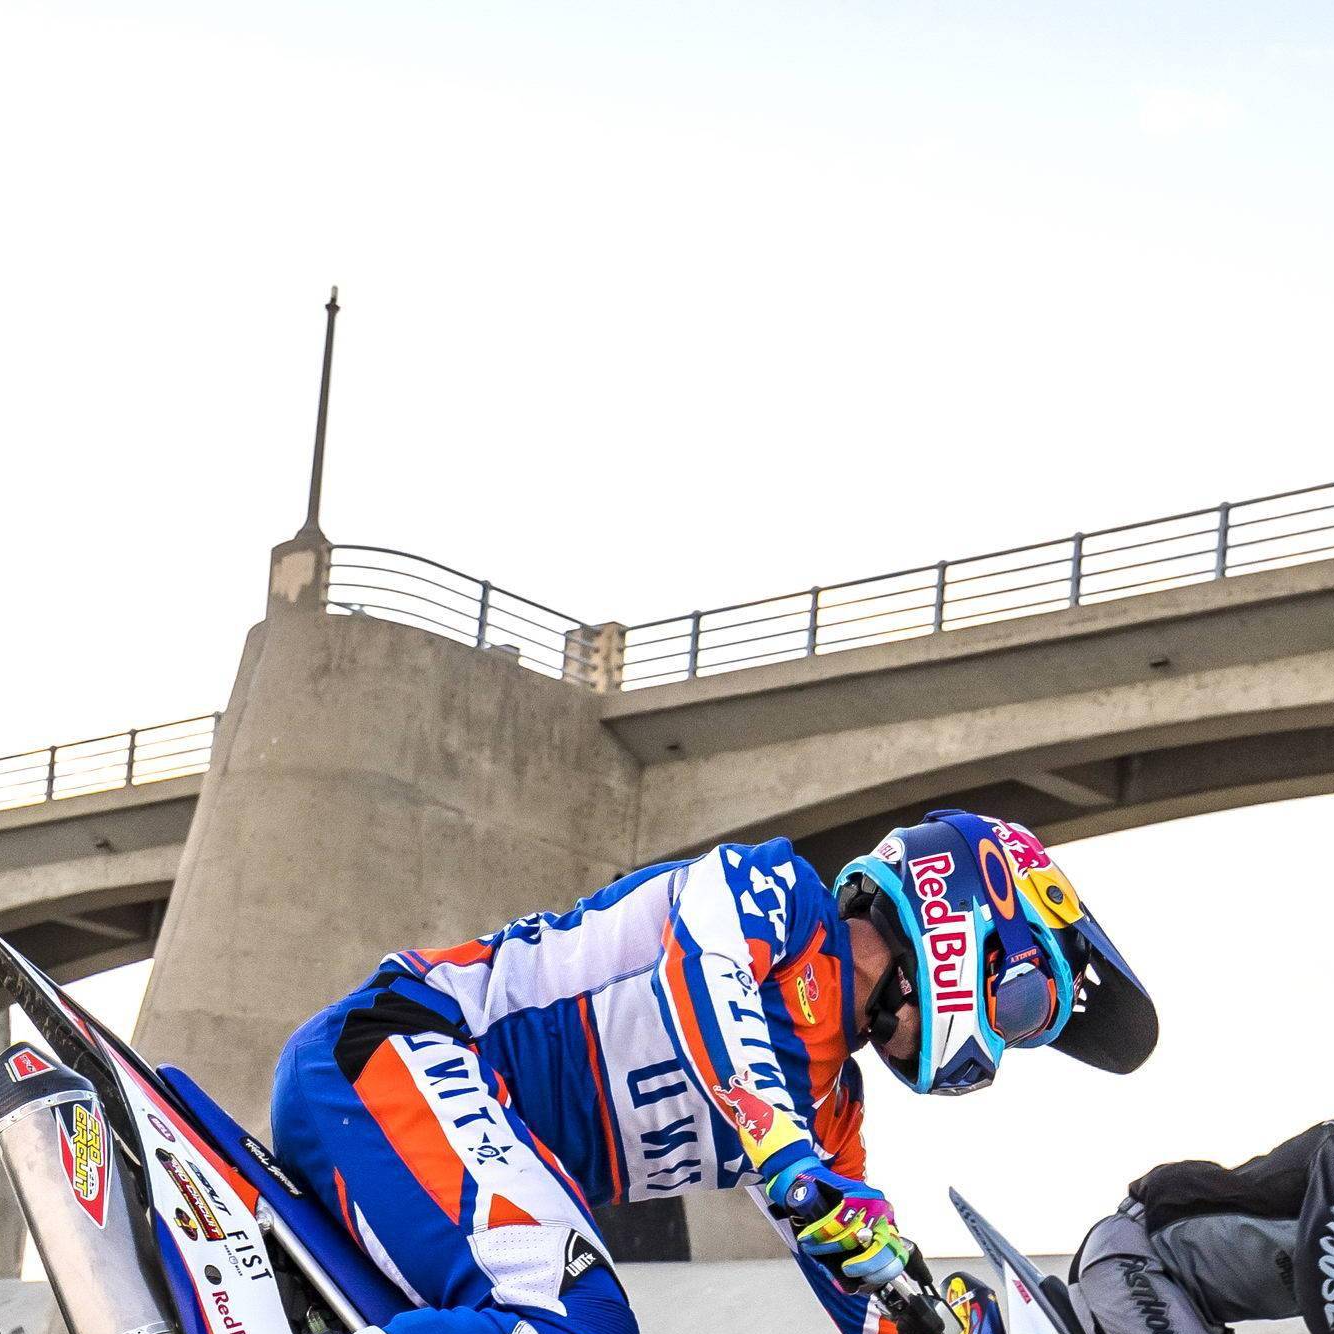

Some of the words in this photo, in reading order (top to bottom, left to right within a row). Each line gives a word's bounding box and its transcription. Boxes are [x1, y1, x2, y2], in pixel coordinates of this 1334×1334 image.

[912, 853, 966, 929] Red
[930, 931, 973, 1014] Bull
[73, 1105, 89, 1197] CIRCUIT
[87, 1113, 101, 1166] PRO
[227, 1230, 273, 1280] FIST
[212, 1291, 237, 1332] Red
